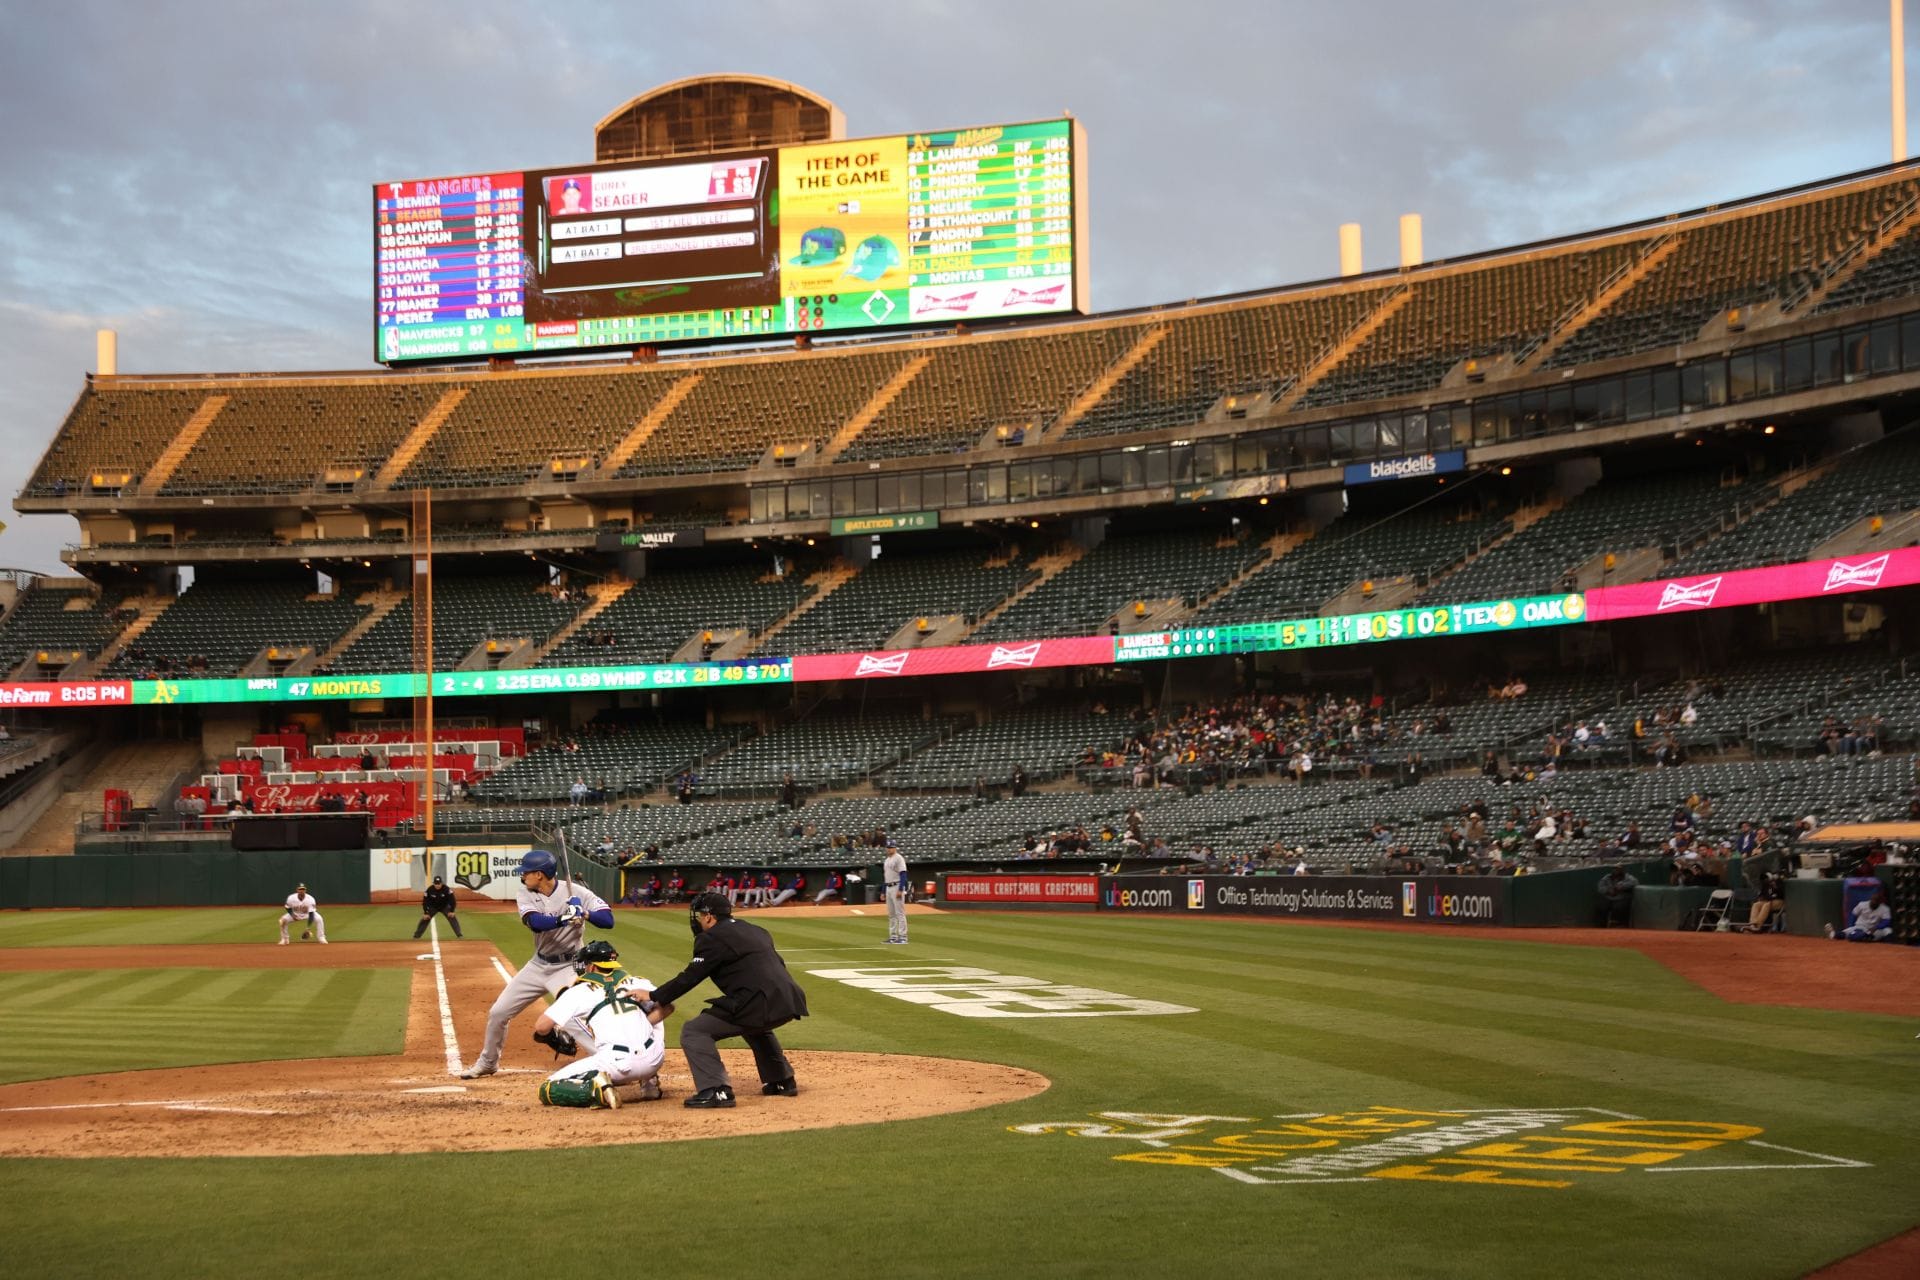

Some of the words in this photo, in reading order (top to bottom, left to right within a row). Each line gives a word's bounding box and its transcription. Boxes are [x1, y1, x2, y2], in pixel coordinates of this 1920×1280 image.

[928, 144, 998, 161] LAUREANO
[807, 155, 849, 171] ITEM
[855, 153, 879, 167] OF
[928, 159, 979, 174] LOWRIE
[416, 176, 491, 195] RANGERS
[796, 175, 831, 189] THE
[837, 169, 890, 186] GAME
[595, 193, 648, 208] SEAGER
[929, 186, 985, 200] MURPHY
[397, 195, 440, 209] SEMIEN
[396, 220, 443, 234] GARVER
[475, 216, 492, 228] DH
[929, 211, 1012, 228] BETHANCOURT
[396, 231, 452, 247] CALHOUN
[476, 228, 491, 240] RF
[929, 227, 983, 241] ANDRUS
[396, 245, 426, 259] HEIM
[479, 241, 488, 252] C
[930, 240, 972, 255] SMITH
[396, 258, 440, 271] GARCIA
[476, 254, 491, 265] CF
[382, 274, 395, 286] 30
[396, 271, 430, 284] LOWE
[930, 271, 985, 284] MONTAS
[1007, 266, 1034, 278] ERA
[382, 287, 392, 299] 13
[396, 284, 440, 297] MILLER
[477, 280, 491, 291] LF
[381, 301, 395, 312] 77
[397, 298, 439, 311] IBANEZ
[381, 313, 389, 325] P
[396, 311, 433, 324] PEREZ
[466, 308, 490, 319] ERA
[400, 326, 463, 340] MAVERICKS
[538, 324, 576, 335] RANGERS
[400, 342, 459, 355] WARRIORS
[621, 533, 641, 546] HOP
[641, 532, 675, 544] VALLEY
[1463, 606, 1498, 626] TEX
[1523, 600, 1563, 622] OAK
[1331, 618, 1338, 630] 2
[1123, 632, 1164, 649] RANGERS
[1172, 630, 1180, 642] 0
[1282, 625, 1296, 645] 5
[1117, 646, 1169, 661] ATHLETICS
[1173, 645, 1180, 655] 0
[1184, 644, 1192, 655] 0
[247, 679, 278, 690] MPH
[444, 677, 455, 692] 2
[473, 677, 484, 690] 4
[496, 674, 529, 690] 3.25
[530, 674, 562, 688] ERA
[602, 669, 647, 687] WHIP
[723, 666, 743, 681] 49
[746, 665, 758, 680] S
[61, 686, 97, 702] 8:05
[101, 685, 126, 700] PM
[151, 679, 180, 703] A's
[289, 682, 309, 696] 47
[312, 680, 382, 695] MONTAS
[384, 849, 413, 864] 330
[456, 851, 489, 876] 811
[493, 857, 523, 867] Before
[494, 869, 510, 878] you
[1106, 882, 1172, 907] ubeo.com
[1217, 887, 1247, 905] Office
[1250, 887, 1300, 912] Technology
[1302, 888, 1346, 909] Solutions
[1347, 891, 1356, 908] &
[1357, 890, 1394, 910] Services
[1428, 880, 1493, 918] ubeo.com
[1006, 1110, 1262, 1139] 24
[1110, 1105, 1470, 1168] RICKEY
[1250, 1111, 1581, 1176] HENDERSON
[1363, 1119, 1766, 1188] FIELD
